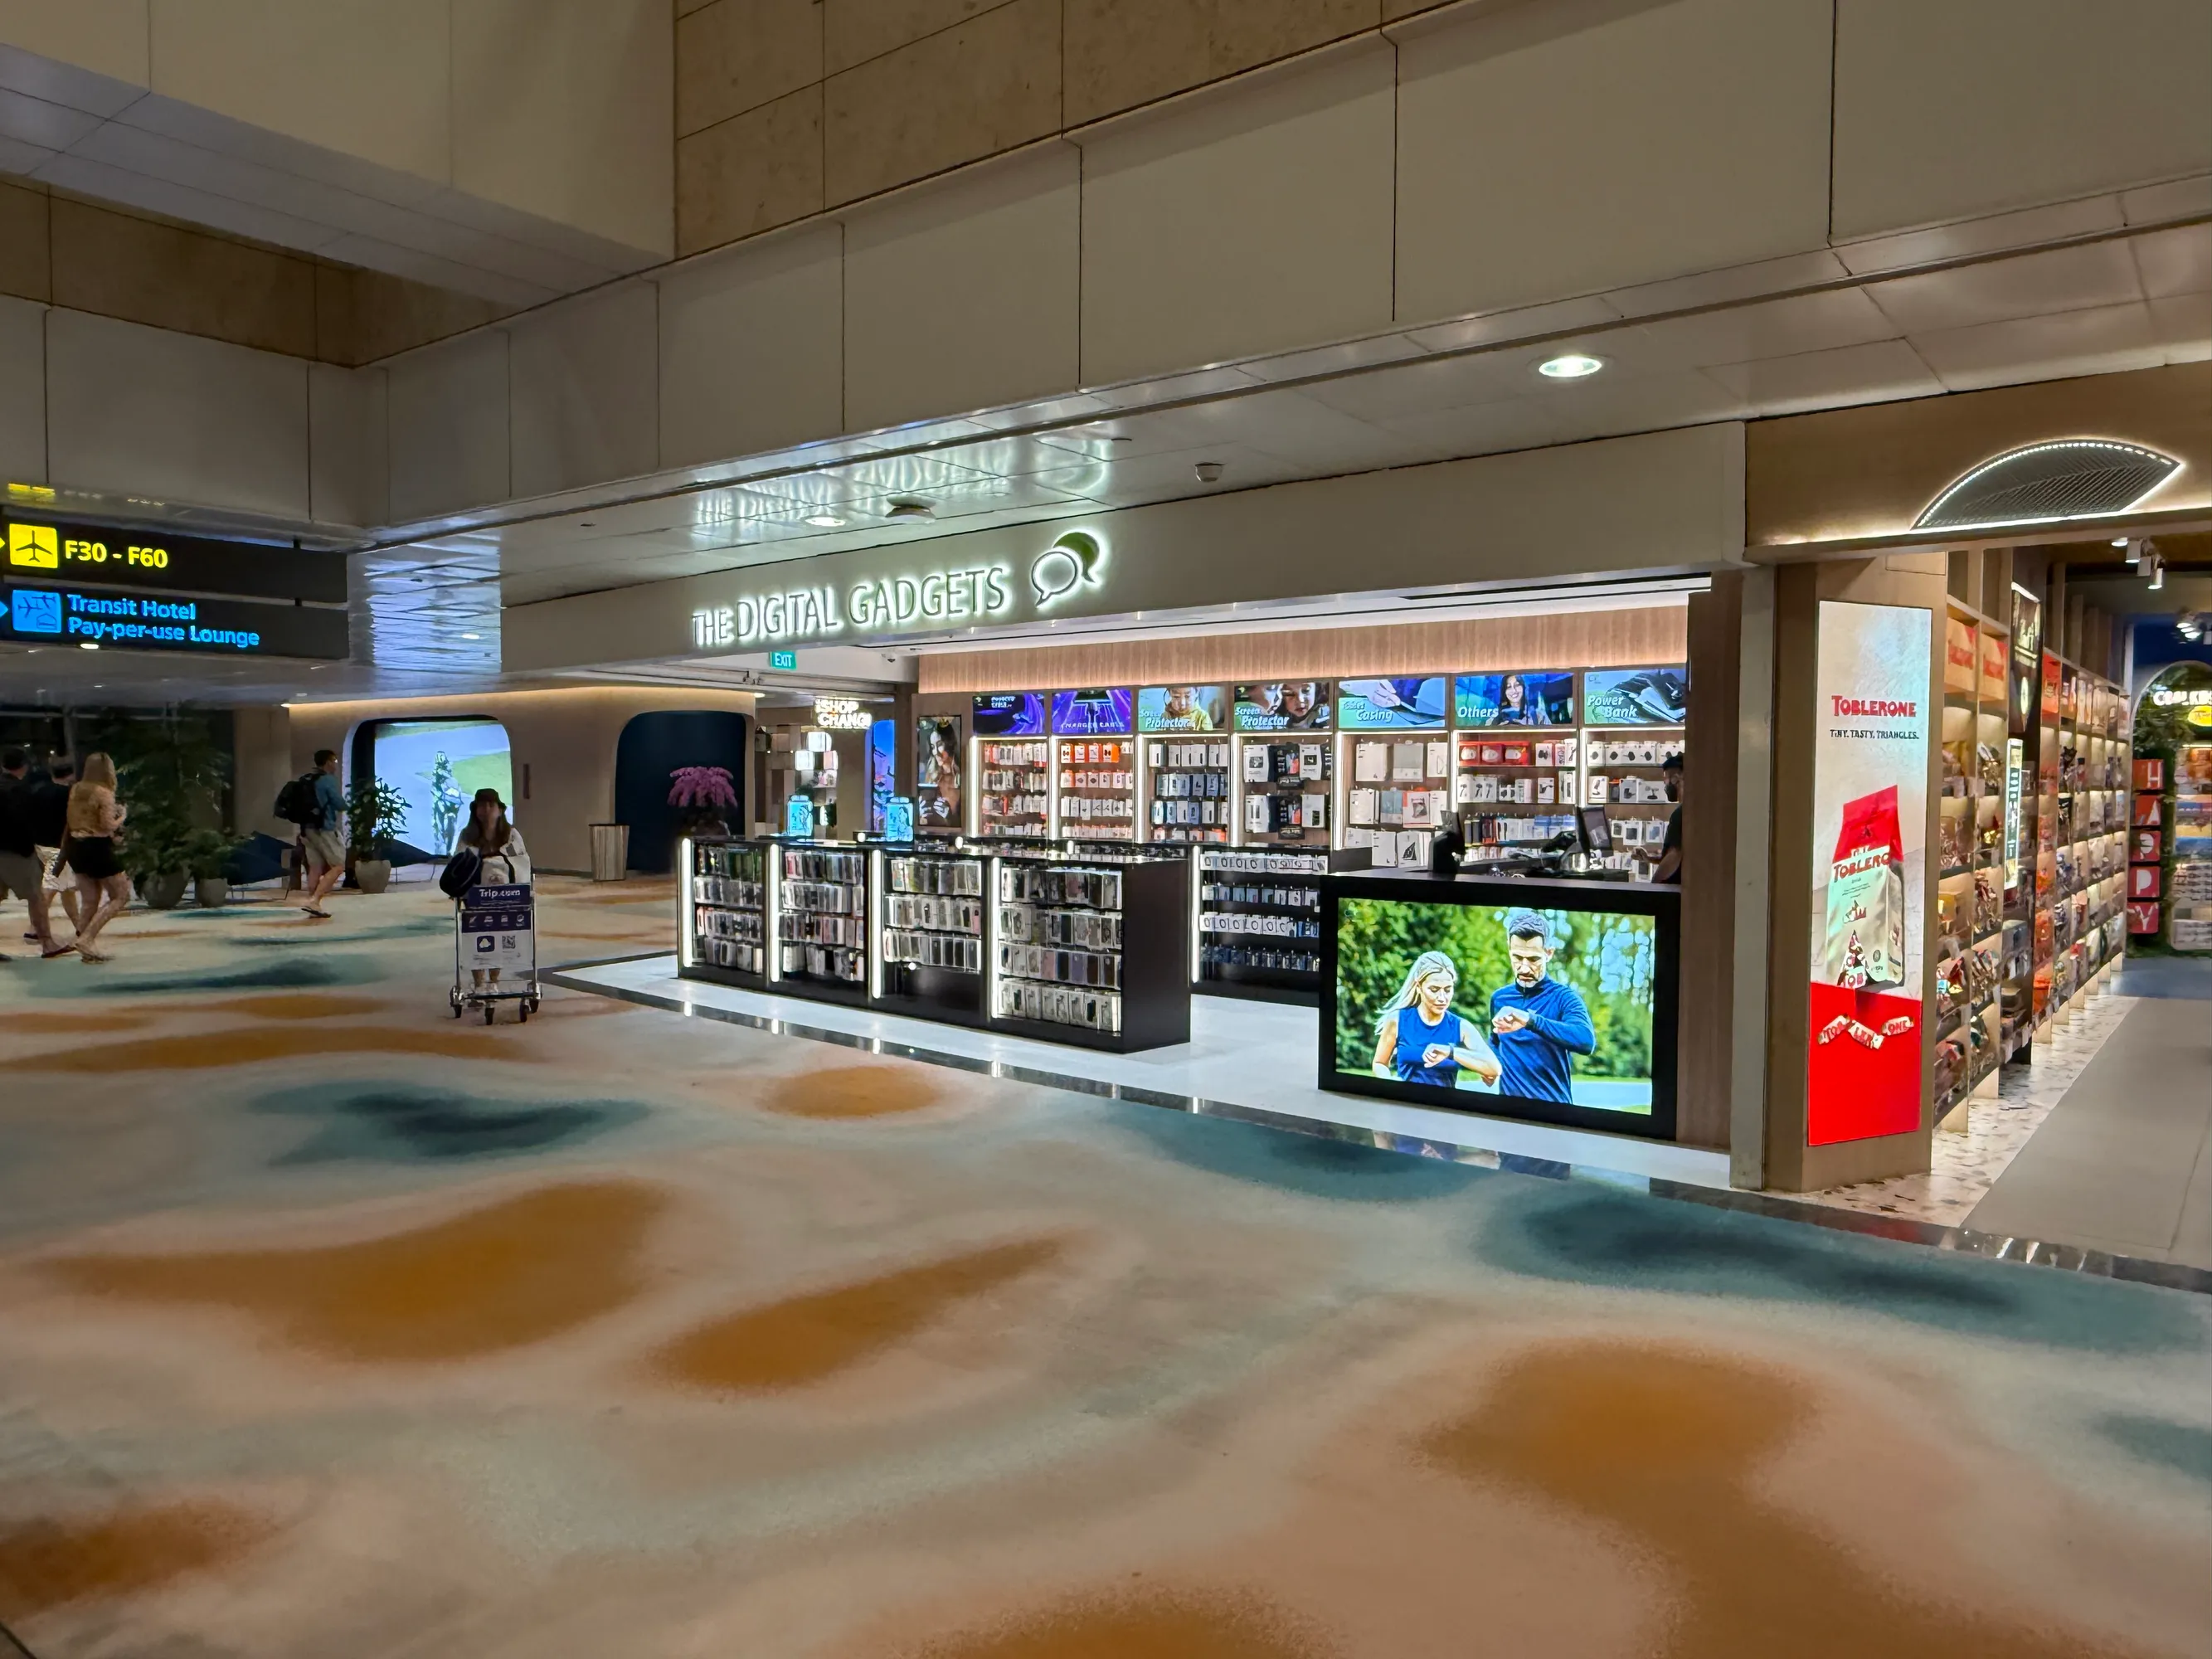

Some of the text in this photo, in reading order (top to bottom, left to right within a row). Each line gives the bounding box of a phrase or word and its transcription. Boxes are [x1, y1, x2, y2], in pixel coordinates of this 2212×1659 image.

[65, 540, 107, 562] F30
[128, 546, 168, 568] F60
[66, 594, 196, 620] Transit Hotel
[692, 566, 1009, 646] THE DIGITAL GADGETS
[68, 616, 260, 648] Pay-per-use Lounge
[775, 654, 792, 667] EXIT
[1587, 694, 1625, 707] Power
[1831, 695, 1917, 718] TOBLERONE
[1356, 710, 1393, 722] Casing
[1457, 705, 1499, 719] Others
[1604, 705, 1638, 718] Bank
[1241, 714, 1289, 727] Protector
[479, 888, 521, 898] Trip.com
